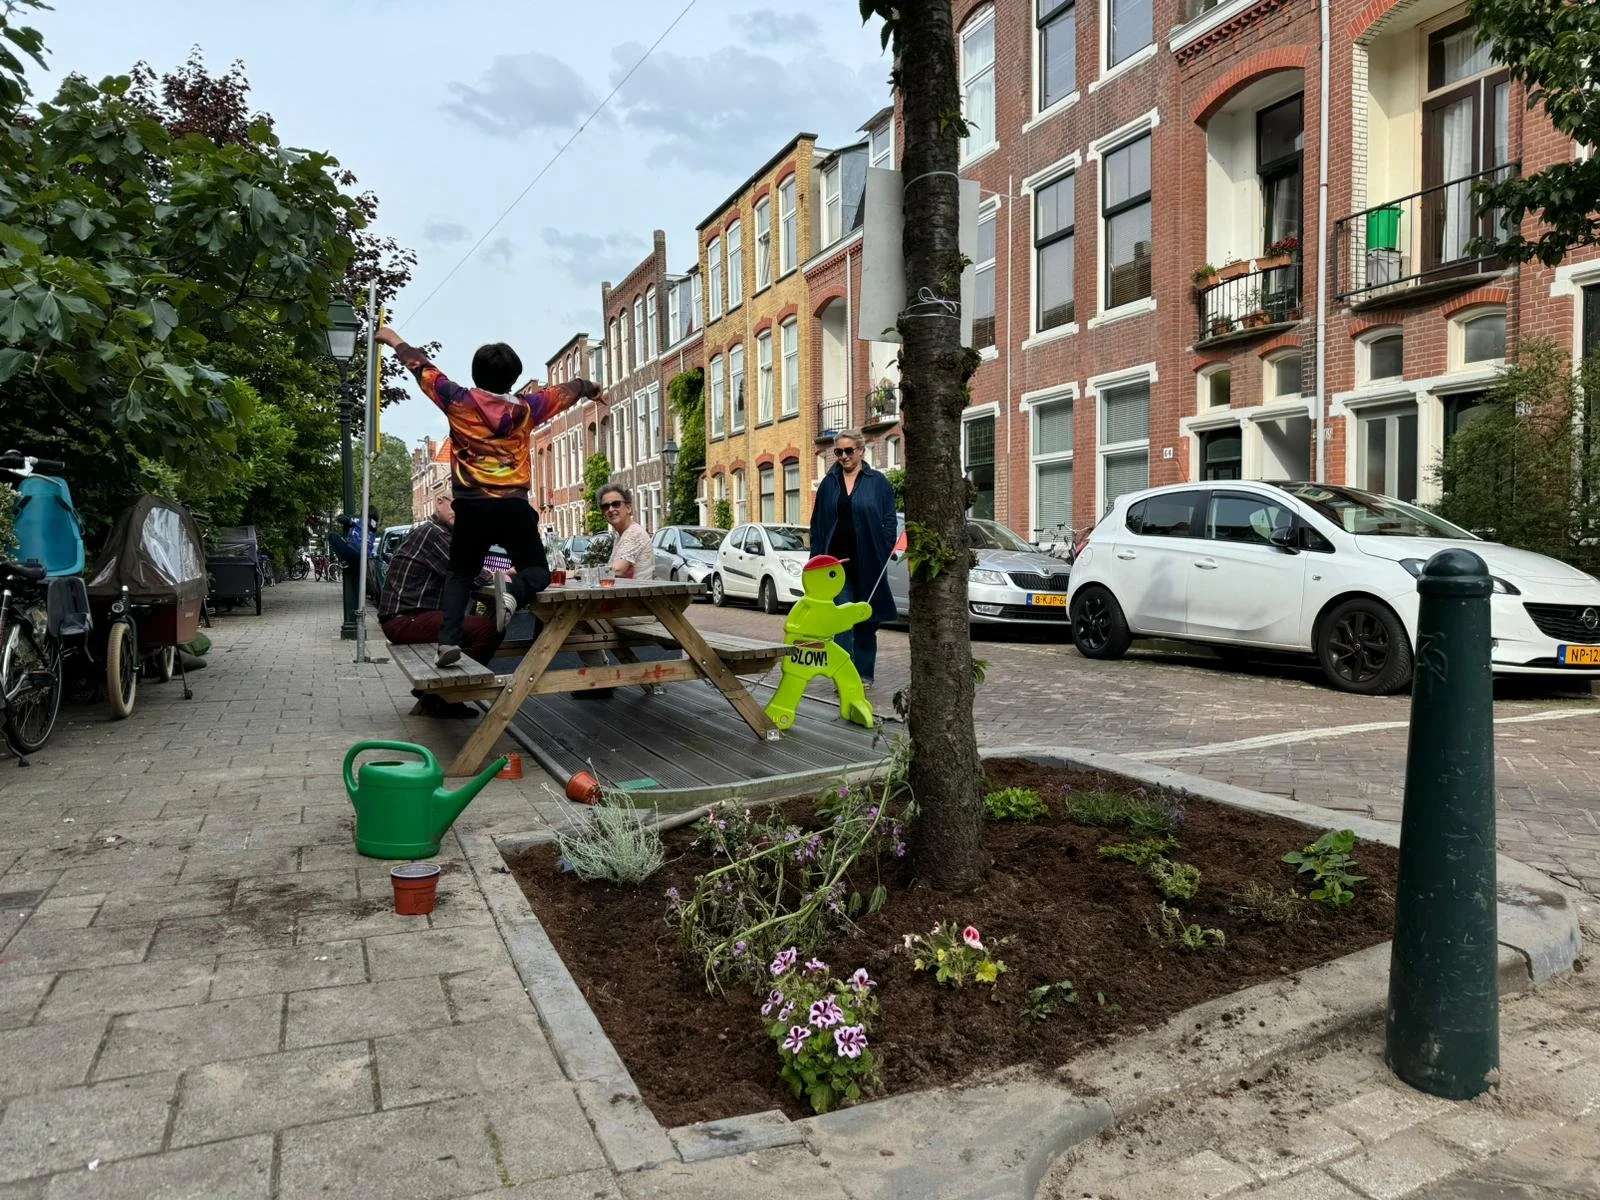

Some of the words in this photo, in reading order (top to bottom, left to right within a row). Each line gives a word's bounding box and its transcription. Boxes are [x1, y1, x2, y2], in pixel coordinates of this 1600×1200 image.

[1035, 595, 1067, 605] 8-KJP-6
[790, 647, 828, 667] SLOW!
[1571, 648, 1600, 663] NP-12
